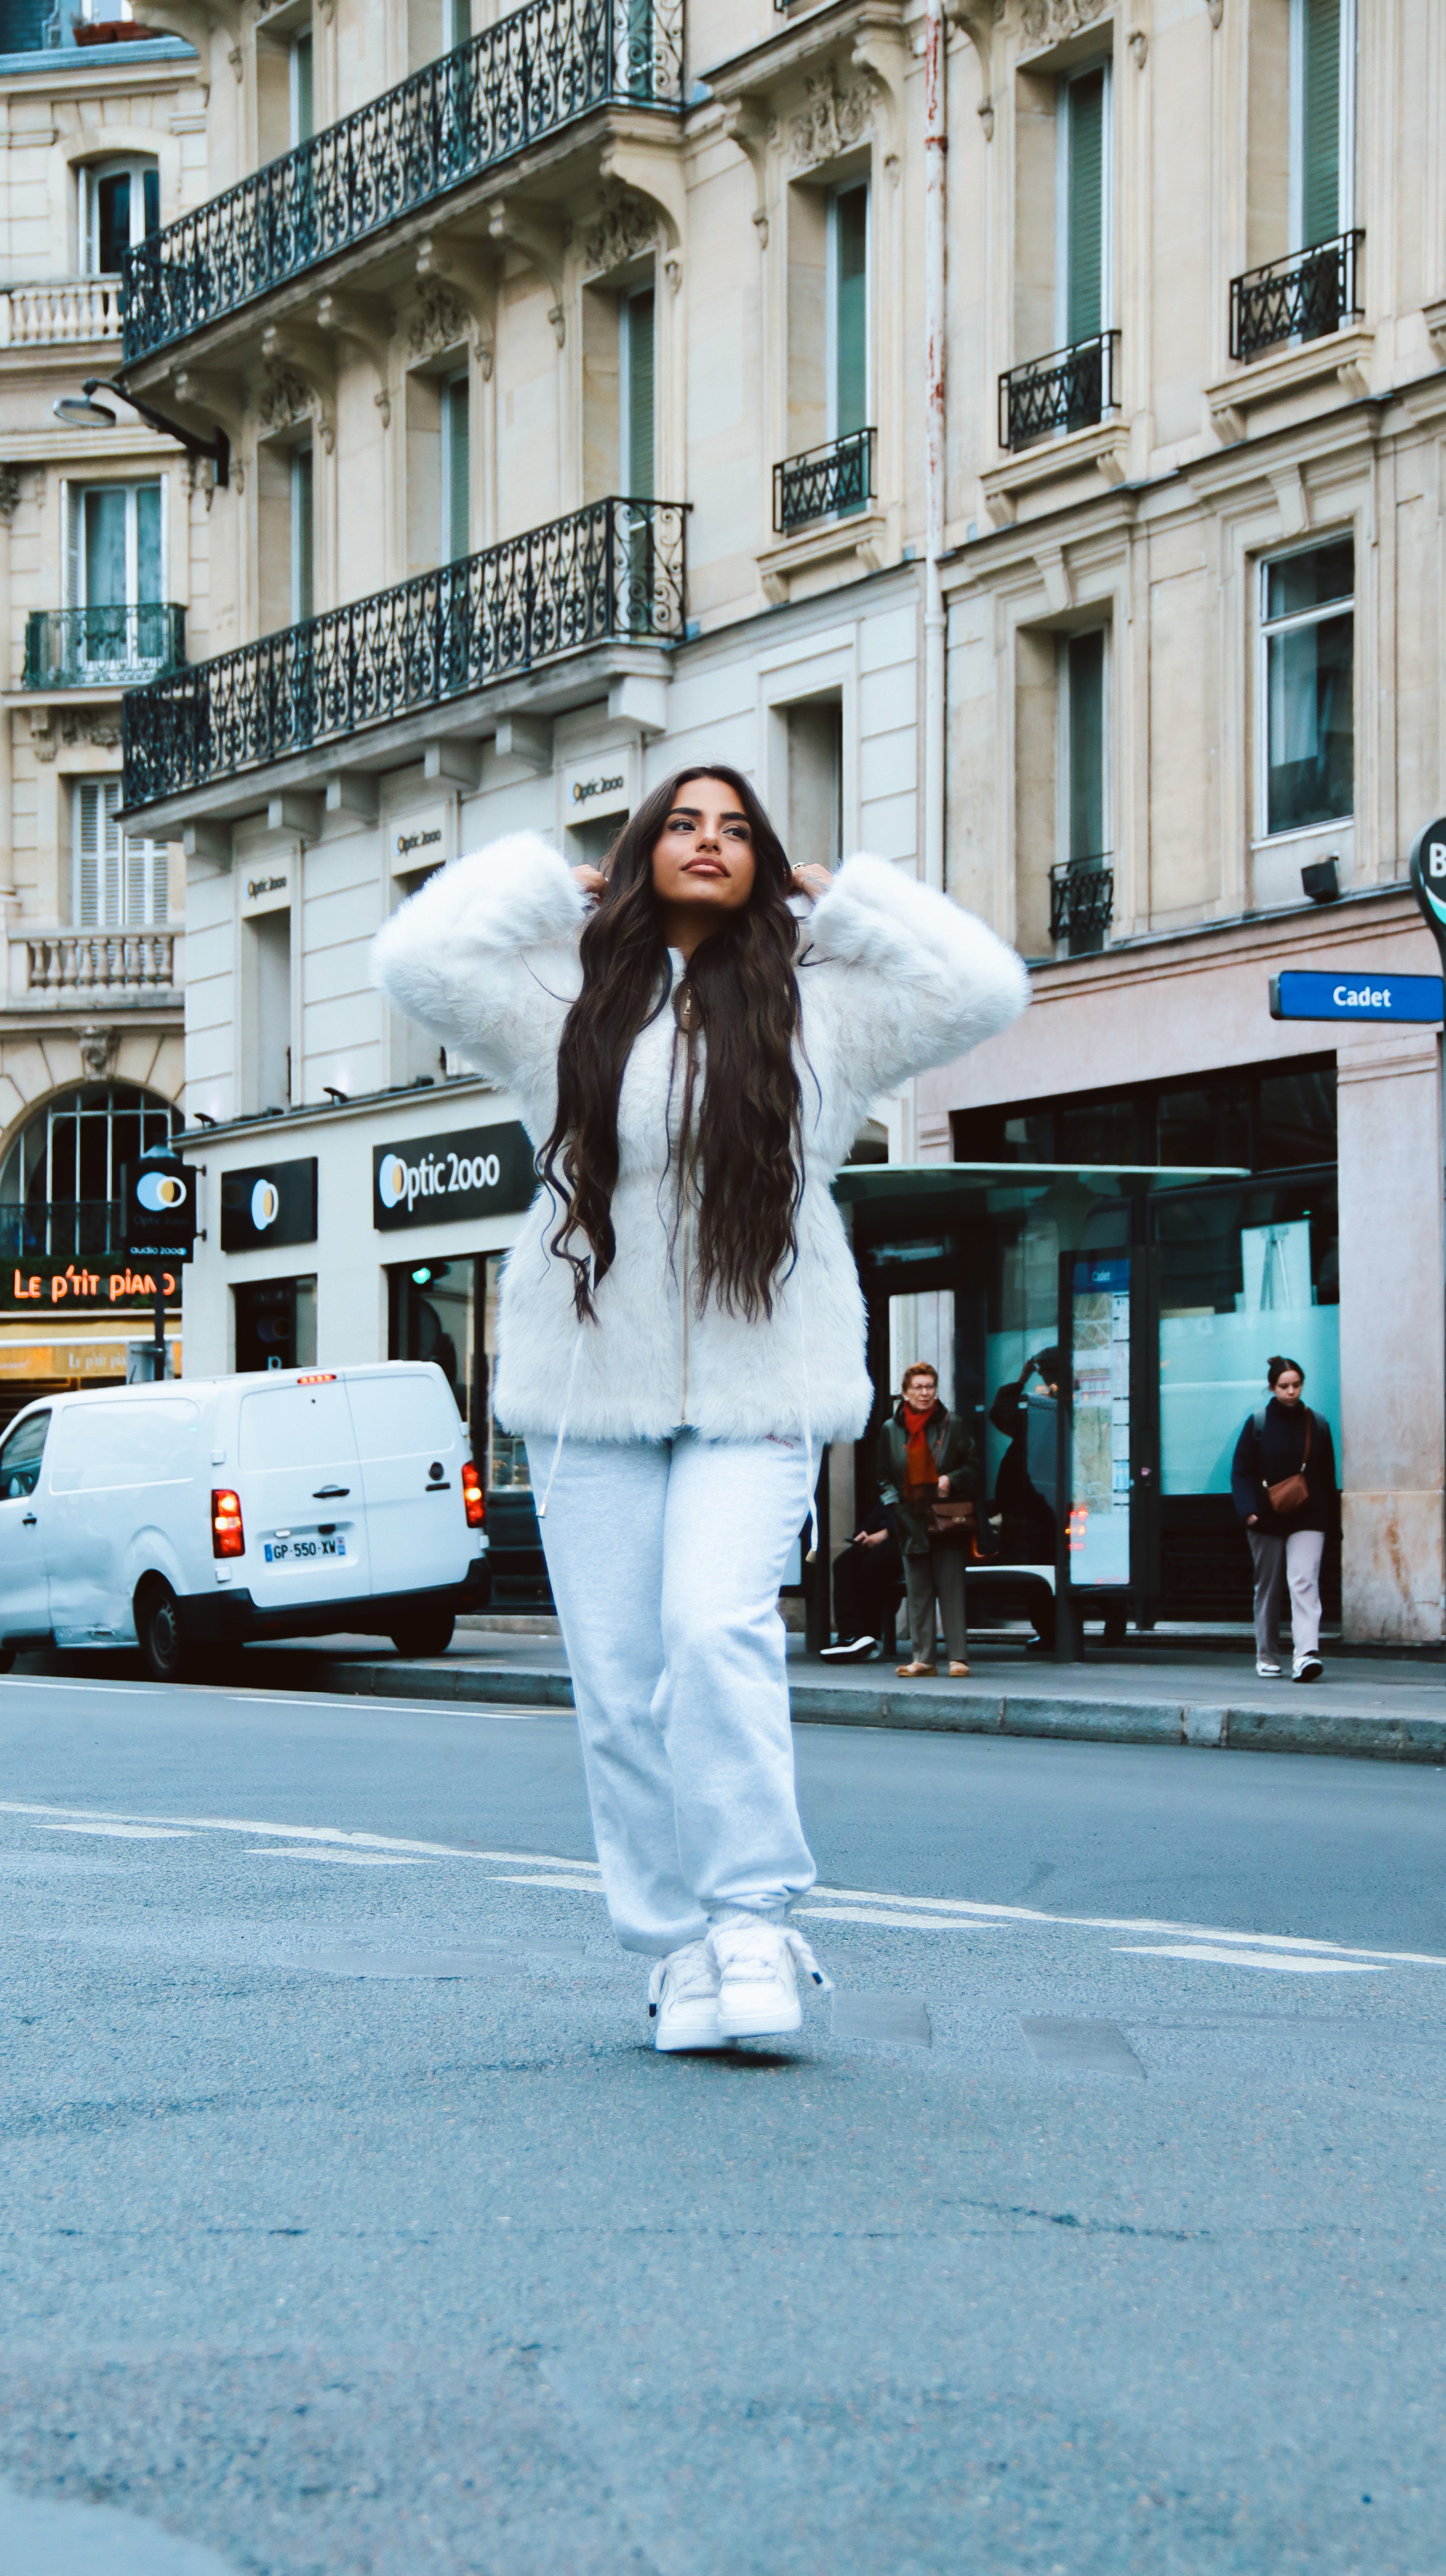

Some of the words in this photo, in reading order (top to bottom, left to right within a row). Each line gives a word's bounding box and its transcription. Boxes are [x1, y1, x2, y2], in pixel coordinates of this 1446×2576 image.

[573, 778, 599, 804] Optic
[600, 776, 623, 793] 2000
[398, 832, 419, 856] Optic
[421, 829, 441, 846] 2000
[248, 877, 268, 900] Optic
[268, 876, 286, 891] 2000
[1333, 985, 1391, 1007] Cadet
[391, 1152, 446, 1212] Optic
[447, 1152, 500, 1192] 2000
[129, 1246, 158, 1255] audio
